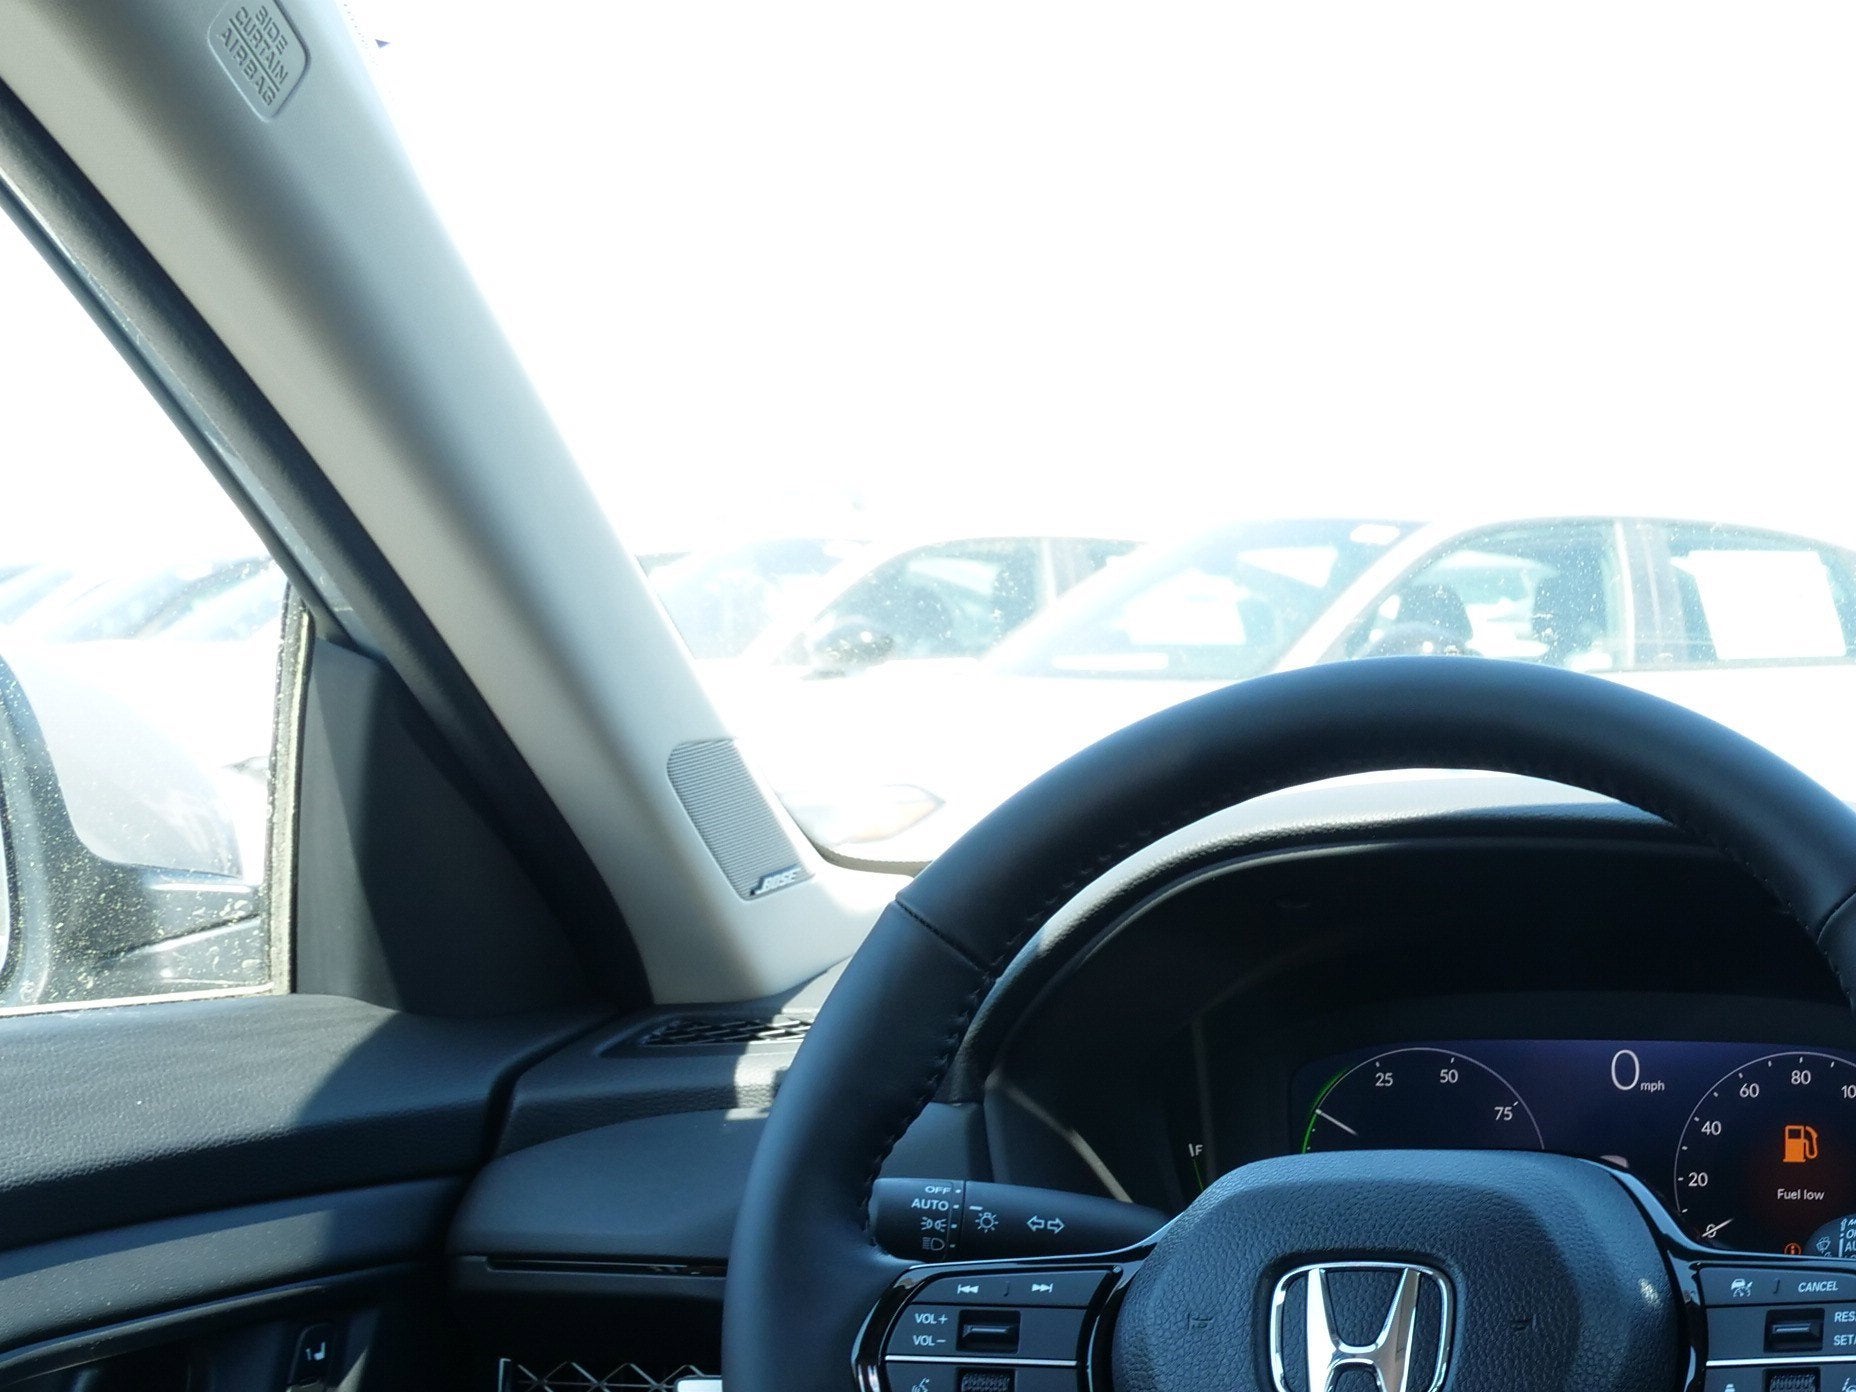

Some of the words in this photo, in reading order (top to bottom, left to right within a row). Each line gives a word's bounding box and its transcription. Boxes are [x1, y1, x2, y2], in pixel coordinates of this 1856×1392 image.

[255, 5, 288, 55] SIDE
[235, 6, 289, 85] CURTAIN
[221, 28, 277, 106] AIRBAG
[1439, 1068, 1459, 1084] 50
[1610, 1049, 1640, 1091] 0
[1790, 1070, 1812, 1085] 80
[1375, 1072, 1394, 1087] 25
[1640, 1081, 1665, 1093] mph
[1739, 1083, 1760, 1099] 60
[1494, 1106, 1514, 1122] 75
[1701, 1121, 1722, 1136] 40
[1688, 1172, 1709, 1187] 20
[924, 1185, 951, 1195] OFF
[1777, 1188, 1801, 1201] Fuel
[1803, 1188, 1825, 1201] low
[910, 1198, 949, 1211] AUTO
[1797, 1281, 1839, 1292] CANCEL
